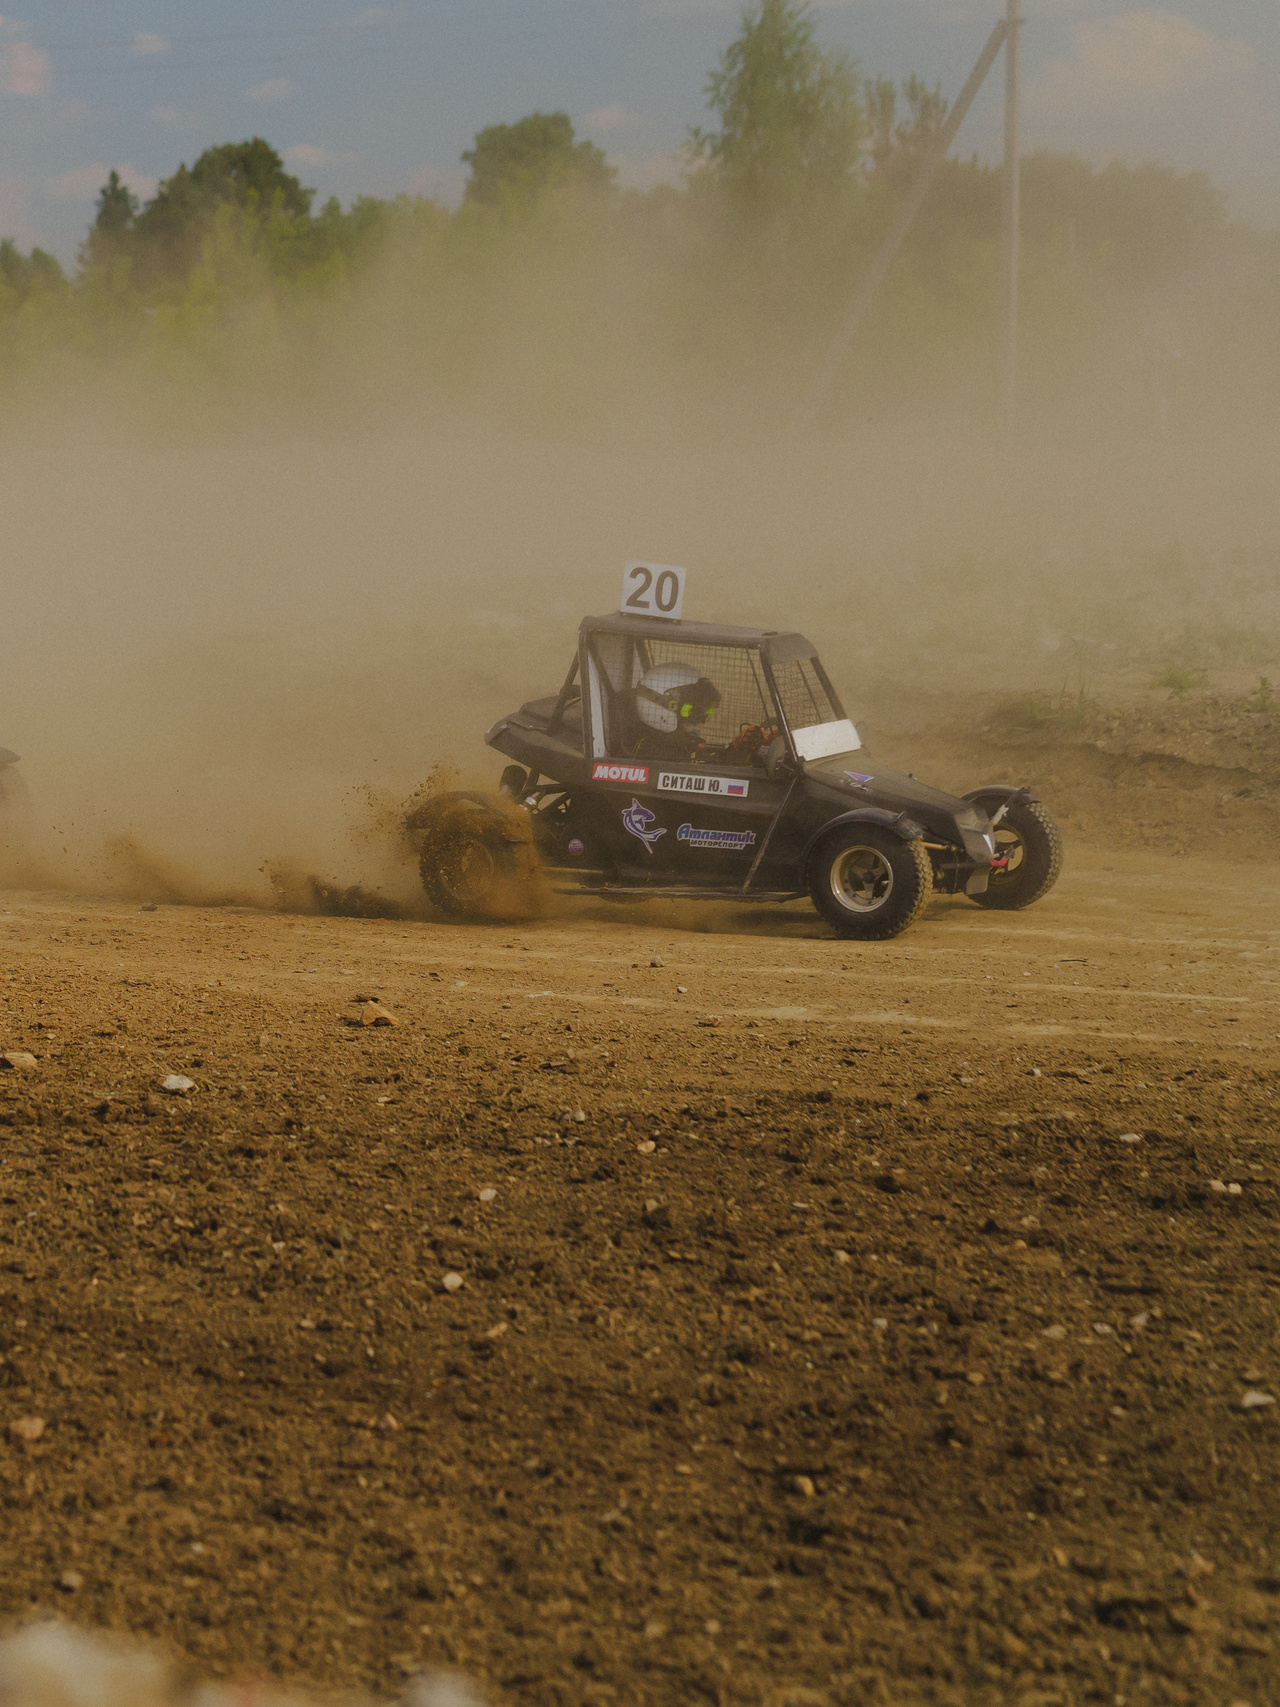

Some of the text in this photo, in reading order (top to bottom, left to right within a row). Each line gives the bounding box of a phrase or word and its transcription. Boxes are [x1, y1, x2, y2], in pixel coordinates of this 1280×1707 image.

[625, 566, 679, 612] 20
[593, 765, 647, 782] MOTUL
[662, 774, 723, 793] СИТАШ Ю.
[677, 823, 756, 844] Атлантик
[690, 840, 745, 850] МОТОРСПОРТ
